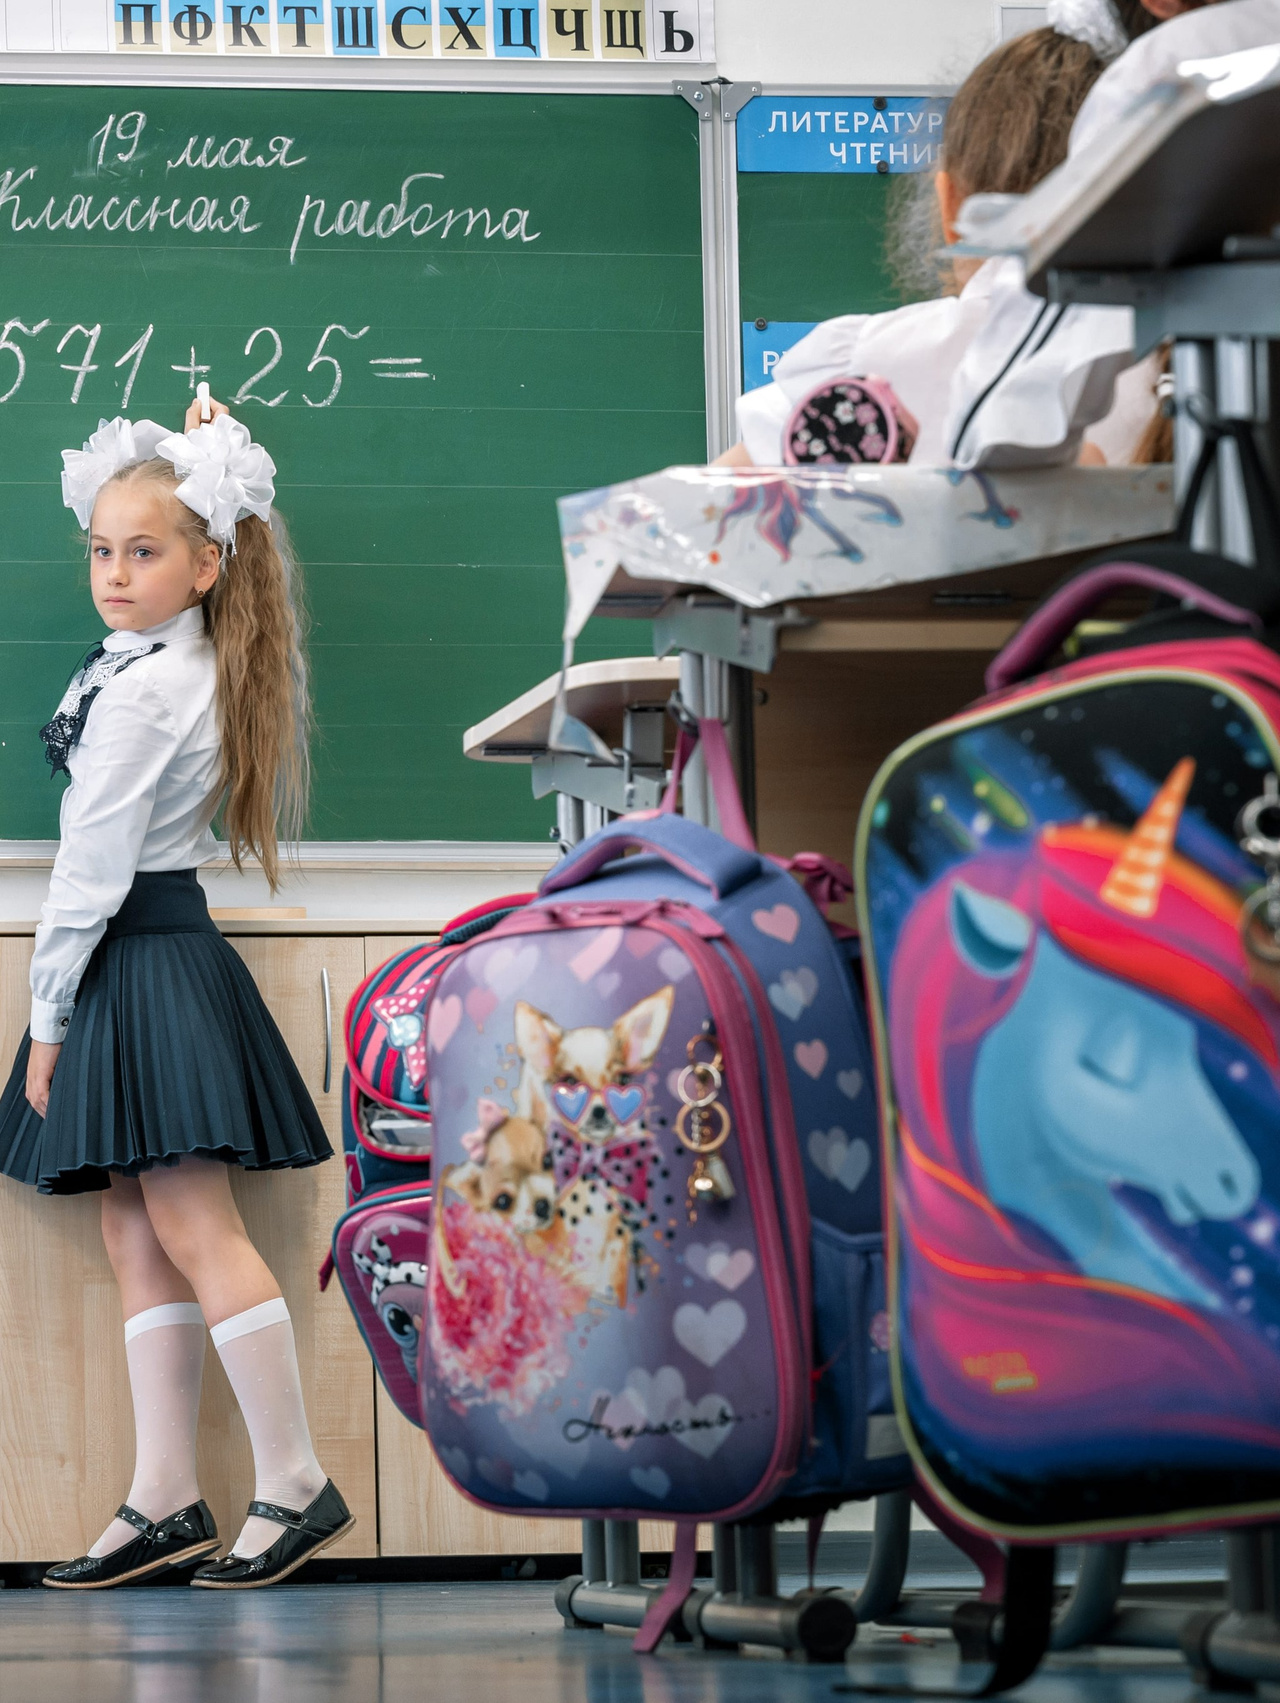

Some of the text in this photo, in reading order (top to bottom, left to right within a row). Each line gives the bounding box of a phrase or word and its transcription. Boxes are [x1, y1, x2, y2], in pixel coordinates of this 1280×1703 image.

[117, 3, 695, 58] П Ф К Т Ш С Х Ц Ч Щ Ь
[94, 110, 309, 173] 19 мая
[768, 110, 944, 133] ЛИТЕРАТУР
[289, 172, 542, 266] работа
